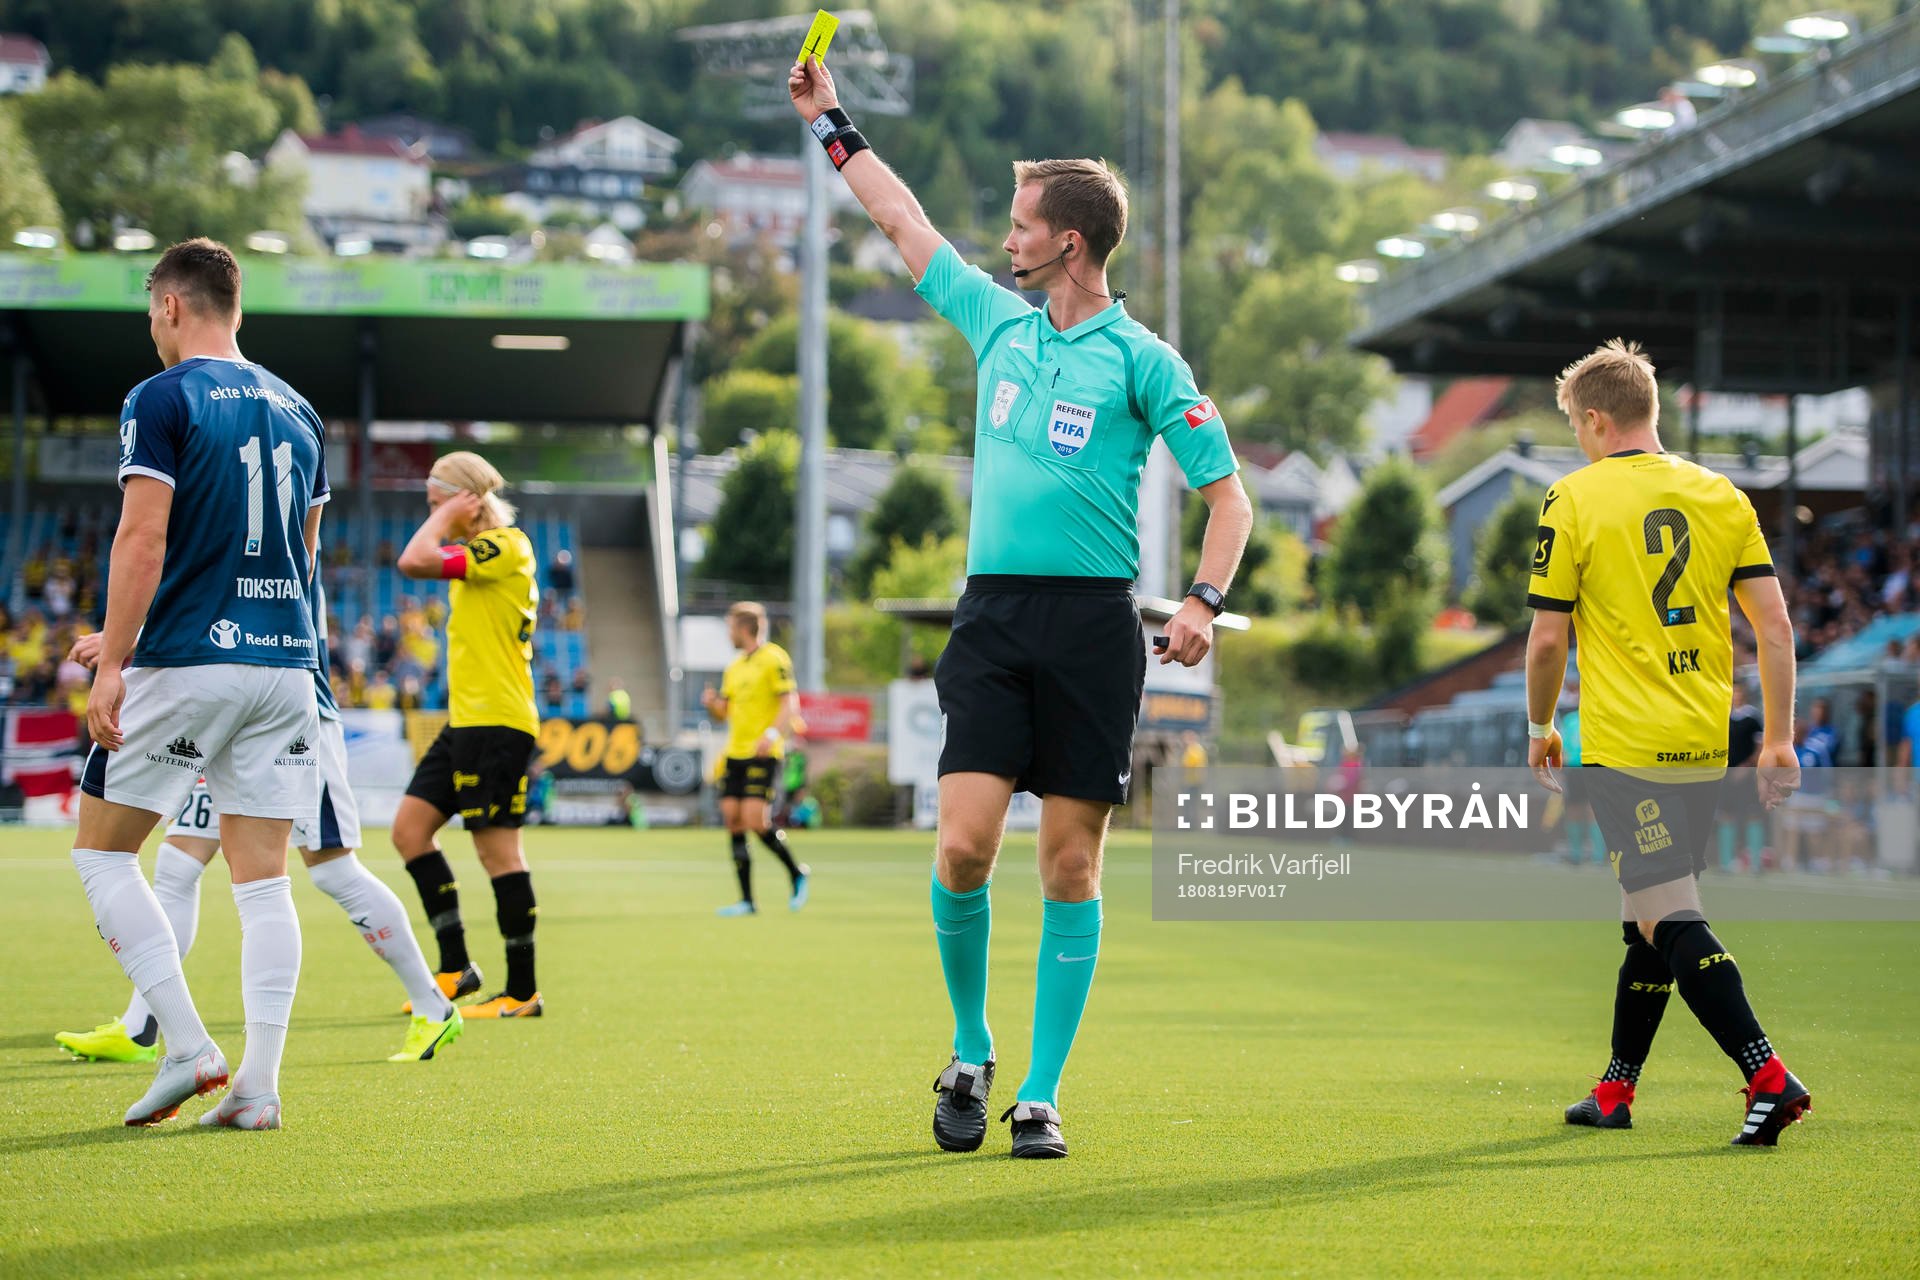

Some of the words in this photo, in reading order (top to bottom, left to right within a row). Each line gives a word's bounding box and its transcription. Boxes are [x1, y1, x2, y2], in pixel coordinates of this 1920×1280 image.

[209, 386, 241, 400] ekte
[1056, 404, 1092, 419] REFEREE
[1053, 420, 1085, 439] FIFA
[1057, 444, 1073, 454] 2018
[239, 436, 293, 558] 11
[1644, 508, 1697, 627] 2
[236, 577, 302, 600] TOKSTAD
[245, 633, 278, 647] Redd
[282, 634, 312, 649] Barna
[1657, 752, 1692, 762] START
[1694, 750, 1710, 761] Life
[177, 793, 213, 829] 26
[1635, 822, 1669, 844] PIZZA
[1639, 837, 1673, 855] BAKEREN
